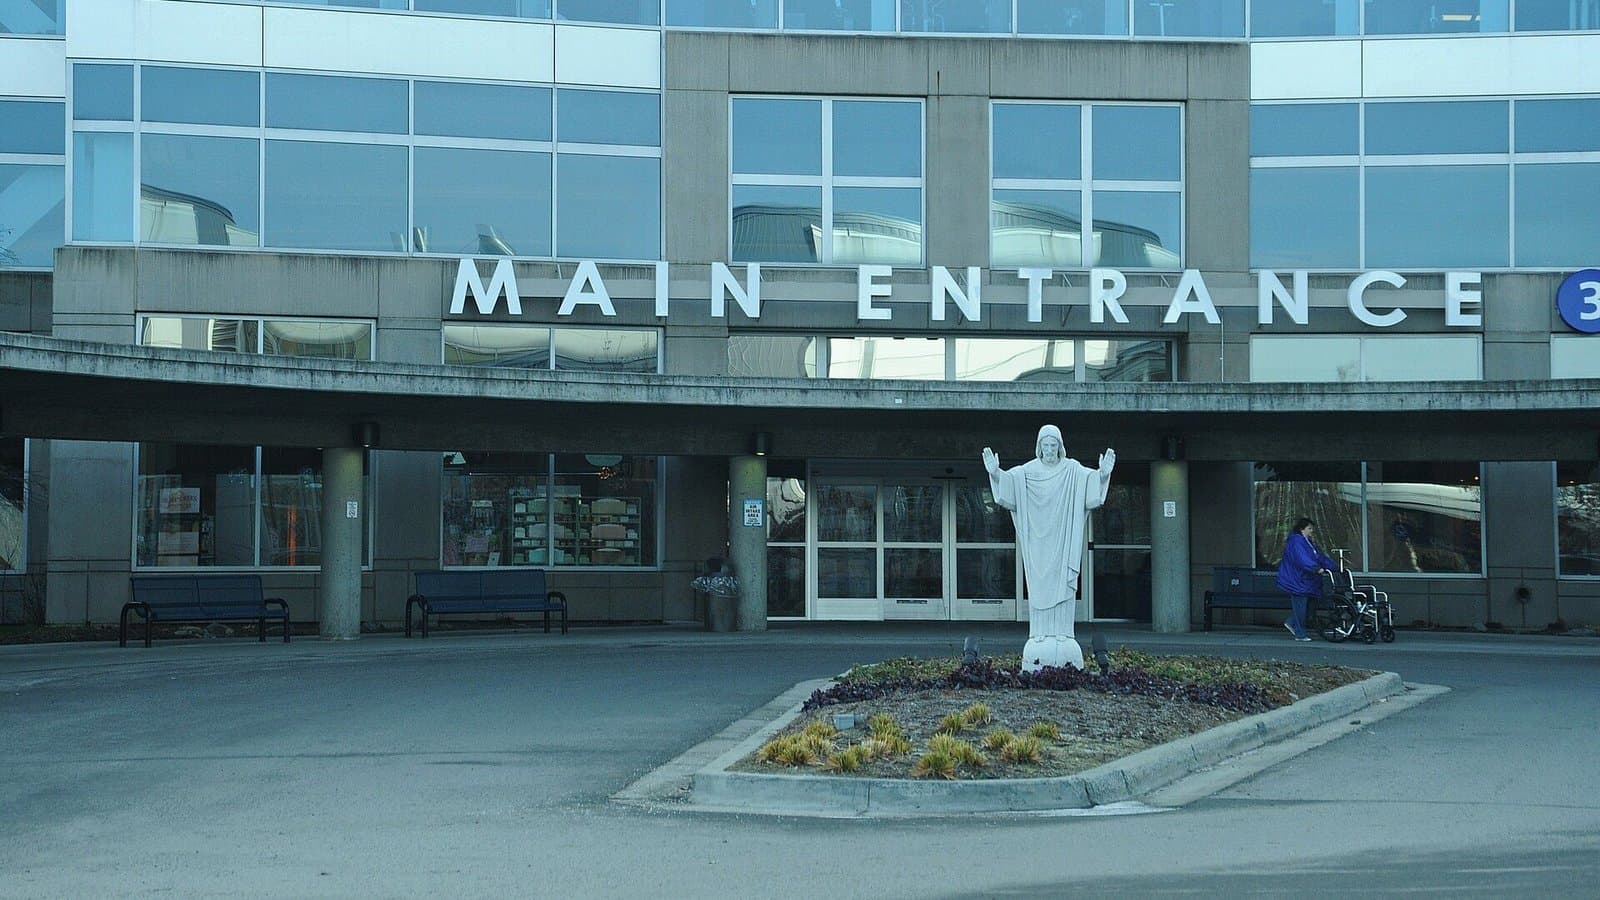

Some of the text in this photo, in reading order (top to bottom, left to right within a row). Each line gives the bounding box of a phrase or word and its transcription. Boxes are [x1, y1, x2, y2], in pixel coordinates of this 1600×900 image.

[450, 258, 1482, 327] MAIN ENTRANCE
[1579, 280, 1600, 320] 3
